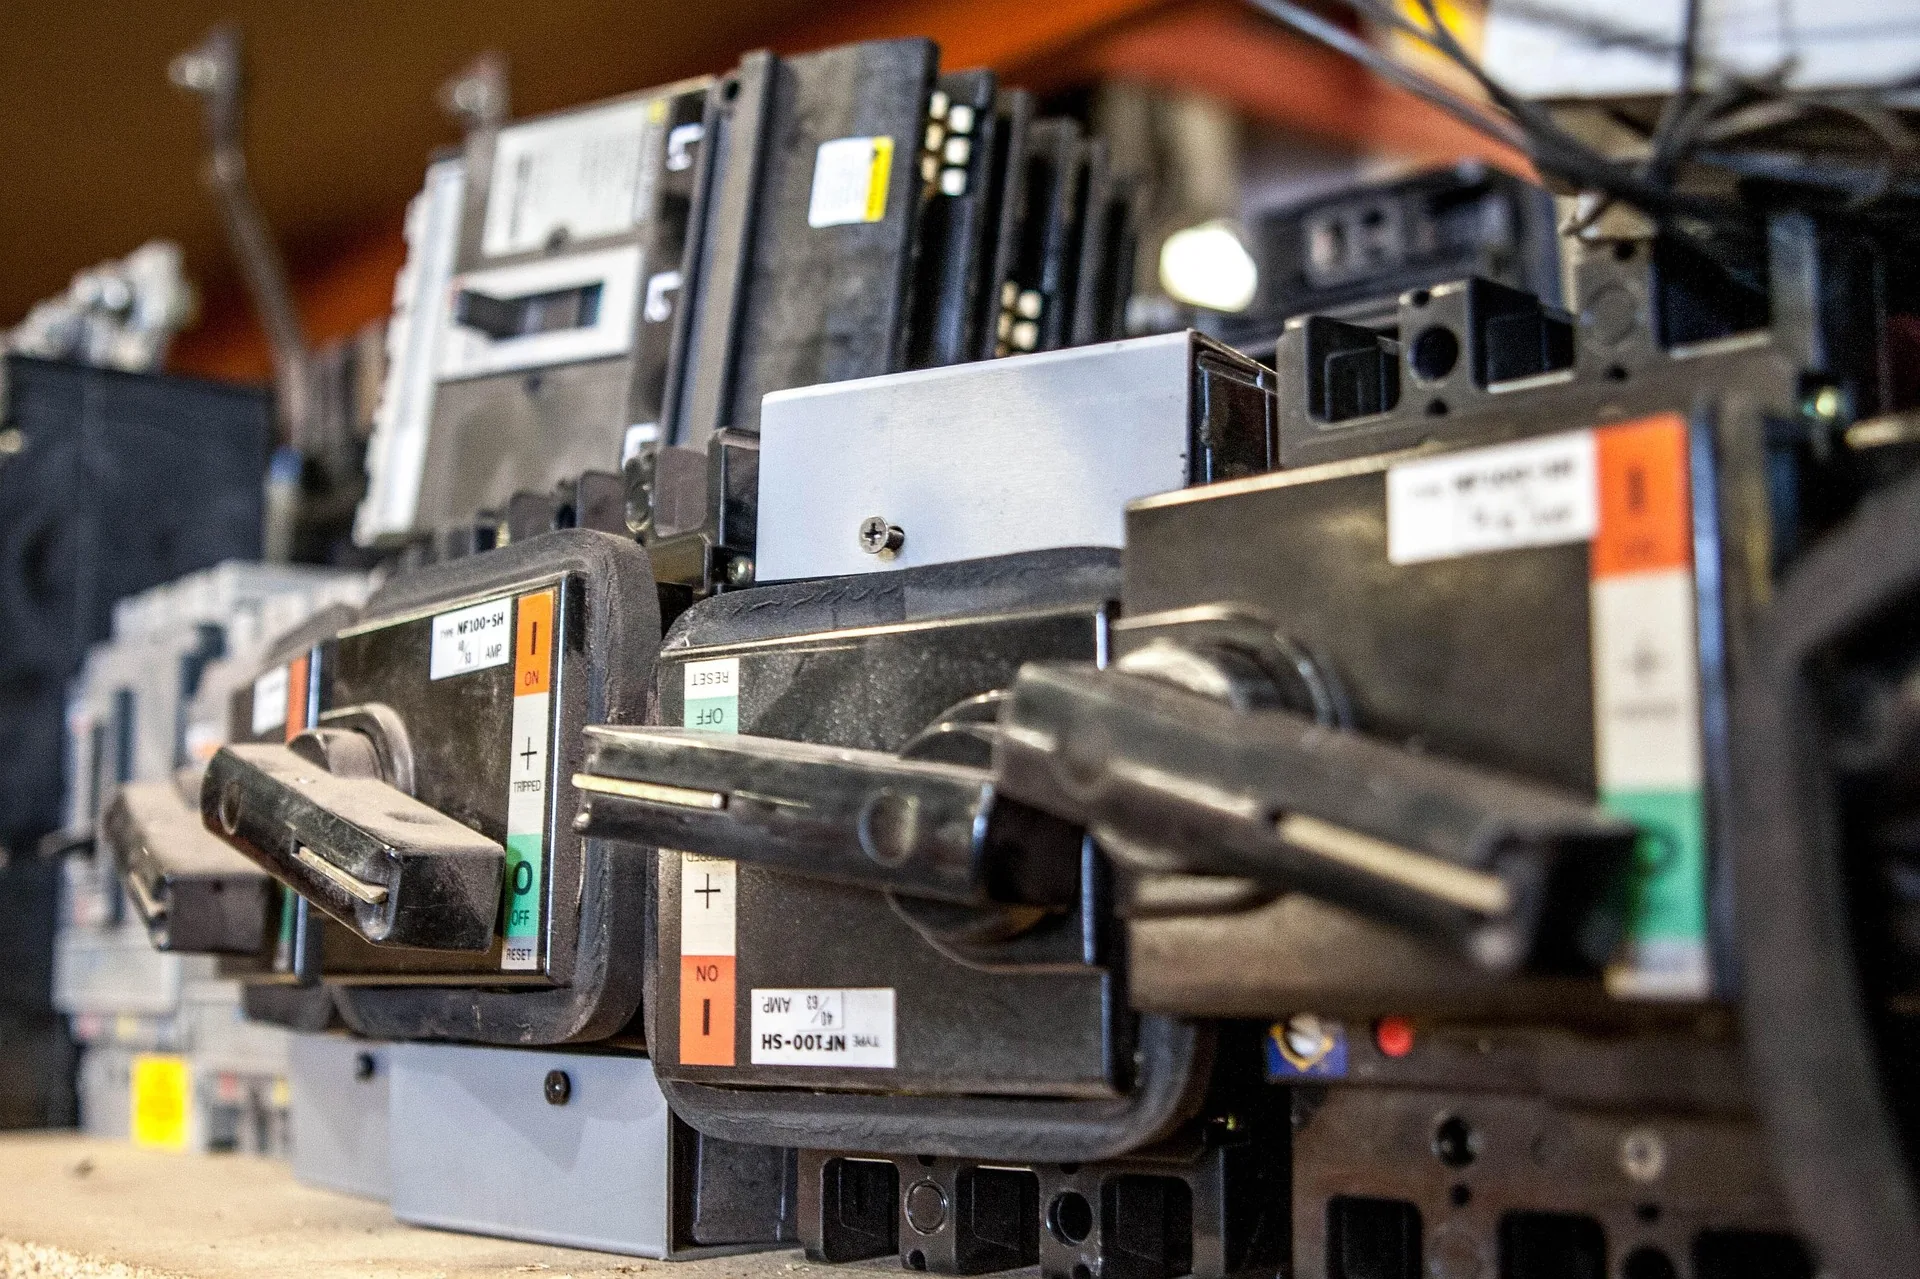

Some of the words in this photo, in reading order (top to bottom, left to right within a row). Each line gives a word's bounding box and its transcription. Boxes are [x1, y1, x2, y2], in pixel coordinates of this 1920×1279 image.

[457, 611, 504, 636] NF100-SH
[524, 670, 539, 687] ON
[691, 670, 729, 686] RESET
[696, 707, 723, 725] OFF
[513, 780, 541, 793] TRIPPED
[511, 909, 529, 926] OFF
[506, 948, 531, 961] RESET
[696, 964, 719, 982] ON
[762, 1033, 846, 1052] NF100-SH
[853, 1035, 880, 1048] TYPE
